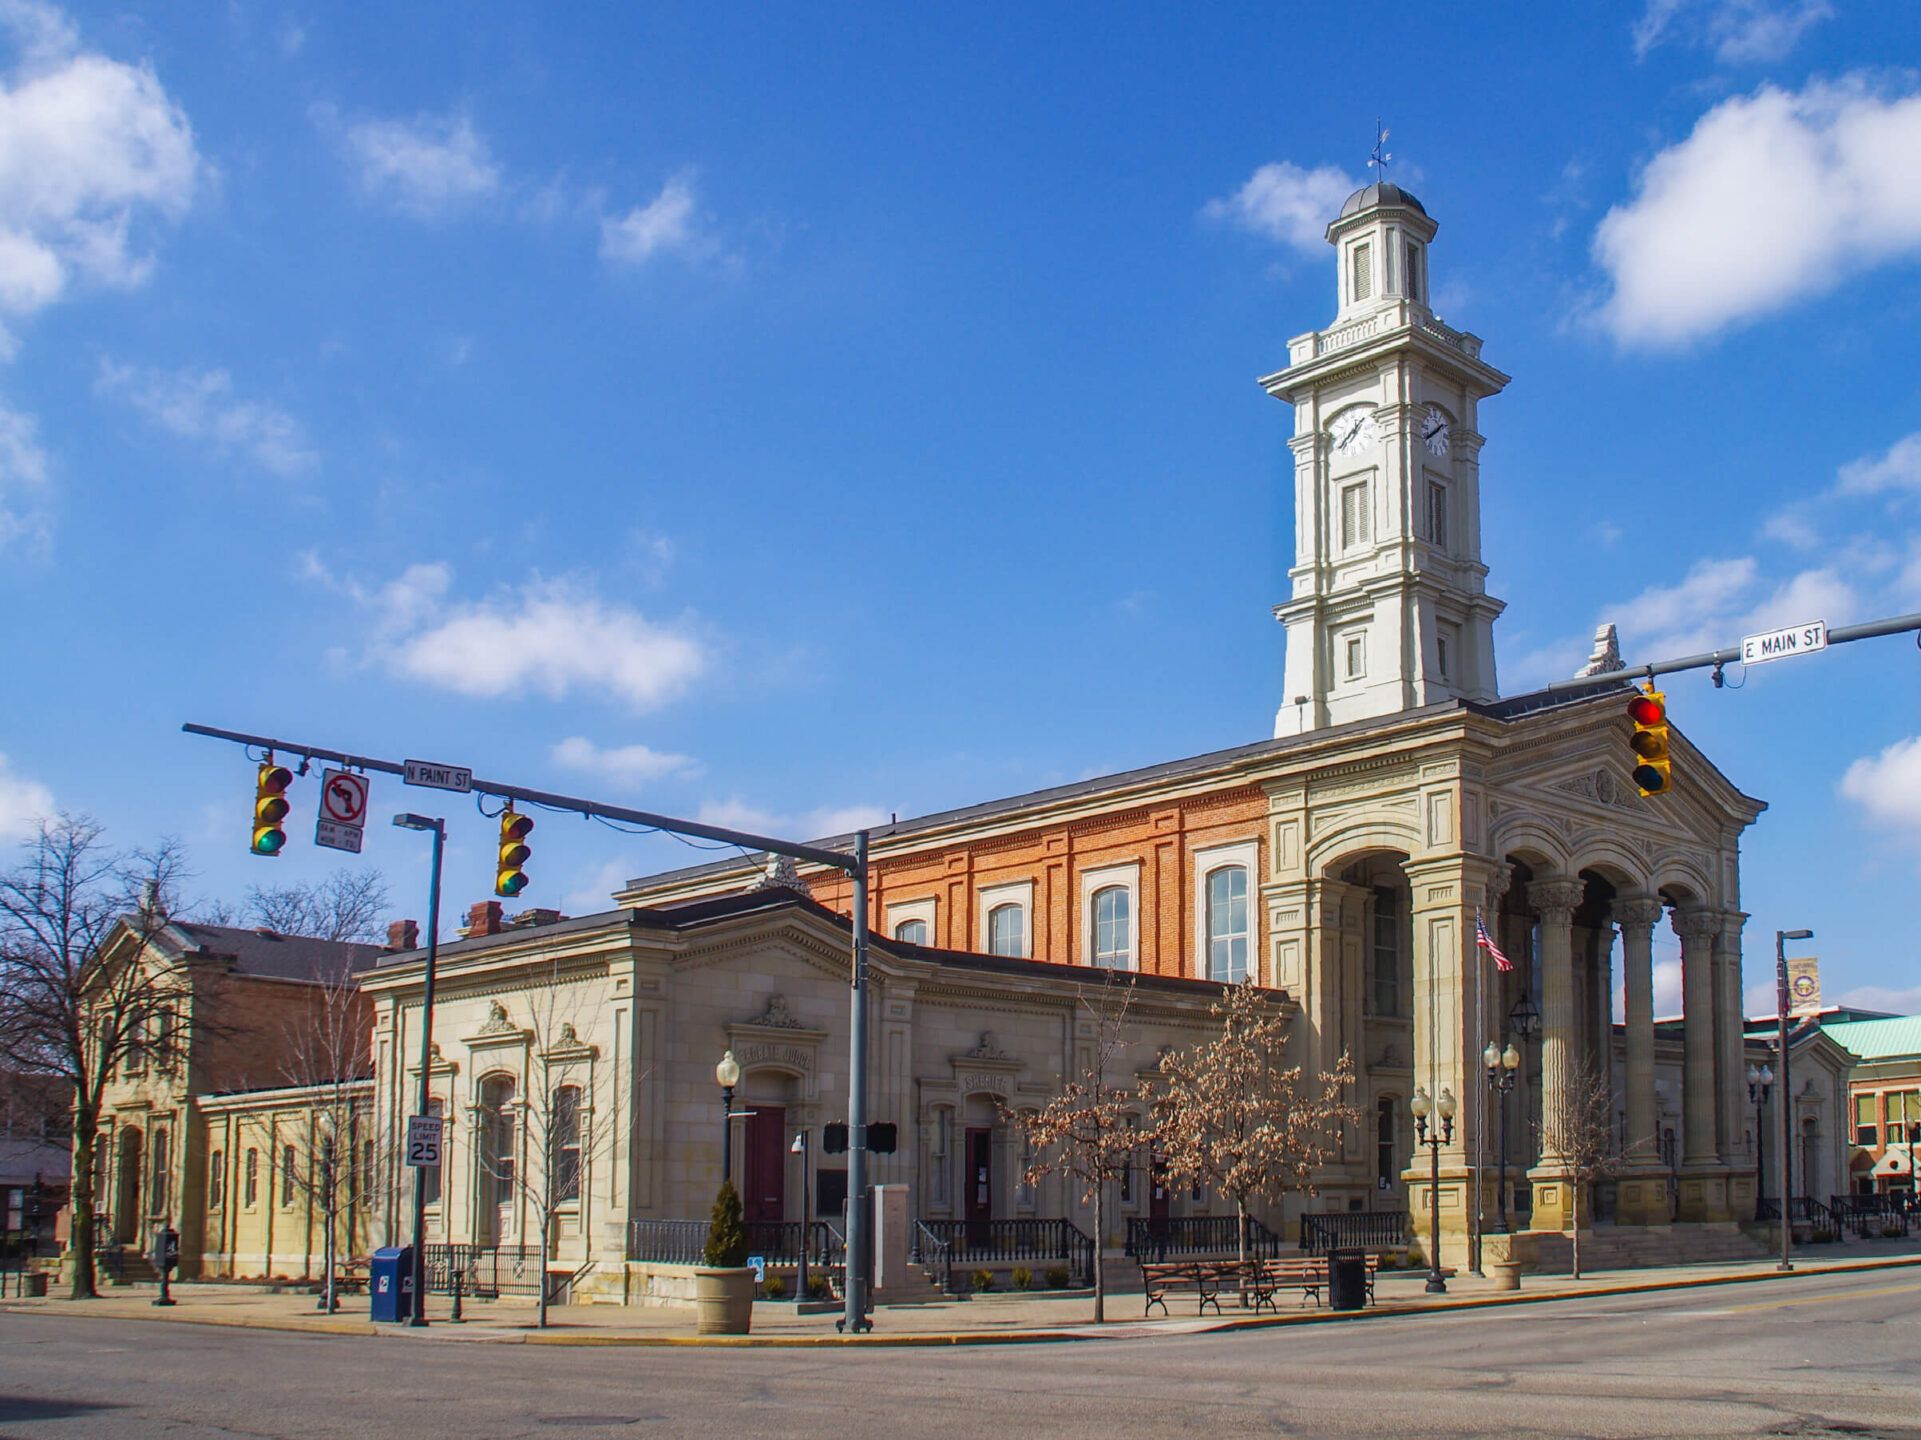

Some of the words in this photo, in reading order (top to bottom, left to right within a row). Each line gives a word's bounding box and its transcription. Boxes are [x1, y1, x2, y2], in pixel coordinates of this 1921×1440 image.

[1746, 642, 1754, 658] E
[1762, 633, 1796, 655] MAIN
[1804, 627, 1821, 646] ST
[407, 766, 415, 780] N
[420, 767, 450, 785] PAINT
[455, 772, 469, 787] ST
[411, 1122, 440, 1131] SPEED
[413, 1132, 437, 1141] LIMIT
[411, 1142, 437, 1161] 25
